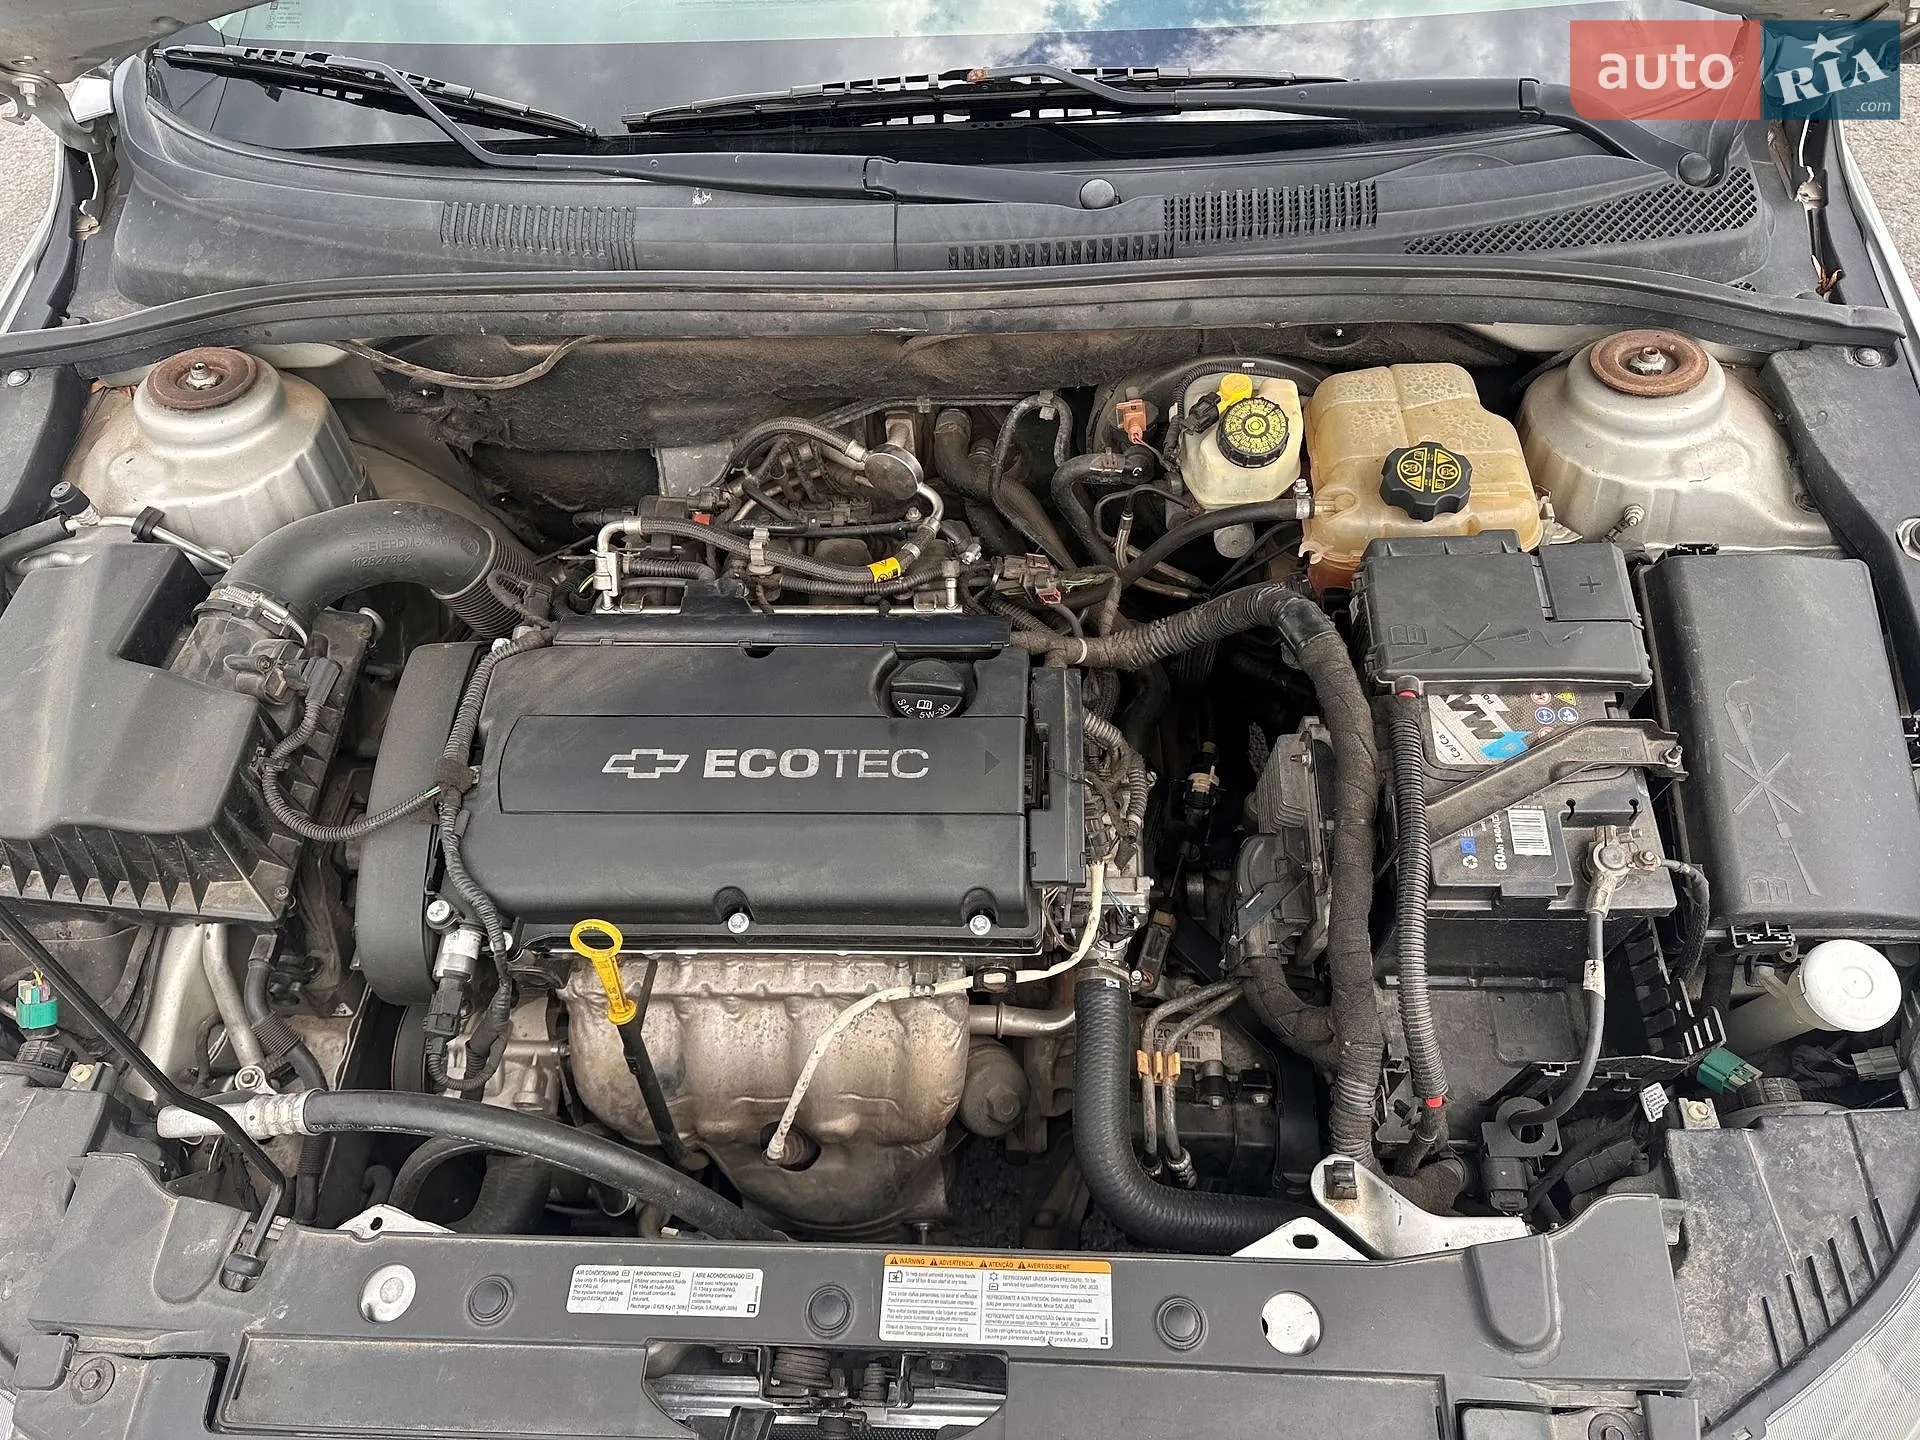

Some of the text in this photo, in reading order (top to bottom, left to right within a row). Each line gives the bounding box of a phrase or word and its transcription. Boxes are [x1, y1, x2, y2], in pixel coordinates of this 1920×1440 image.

[898, 698, 950, 718] SAE 5W-30
[704, 748, 930, 779] ECOTEC
